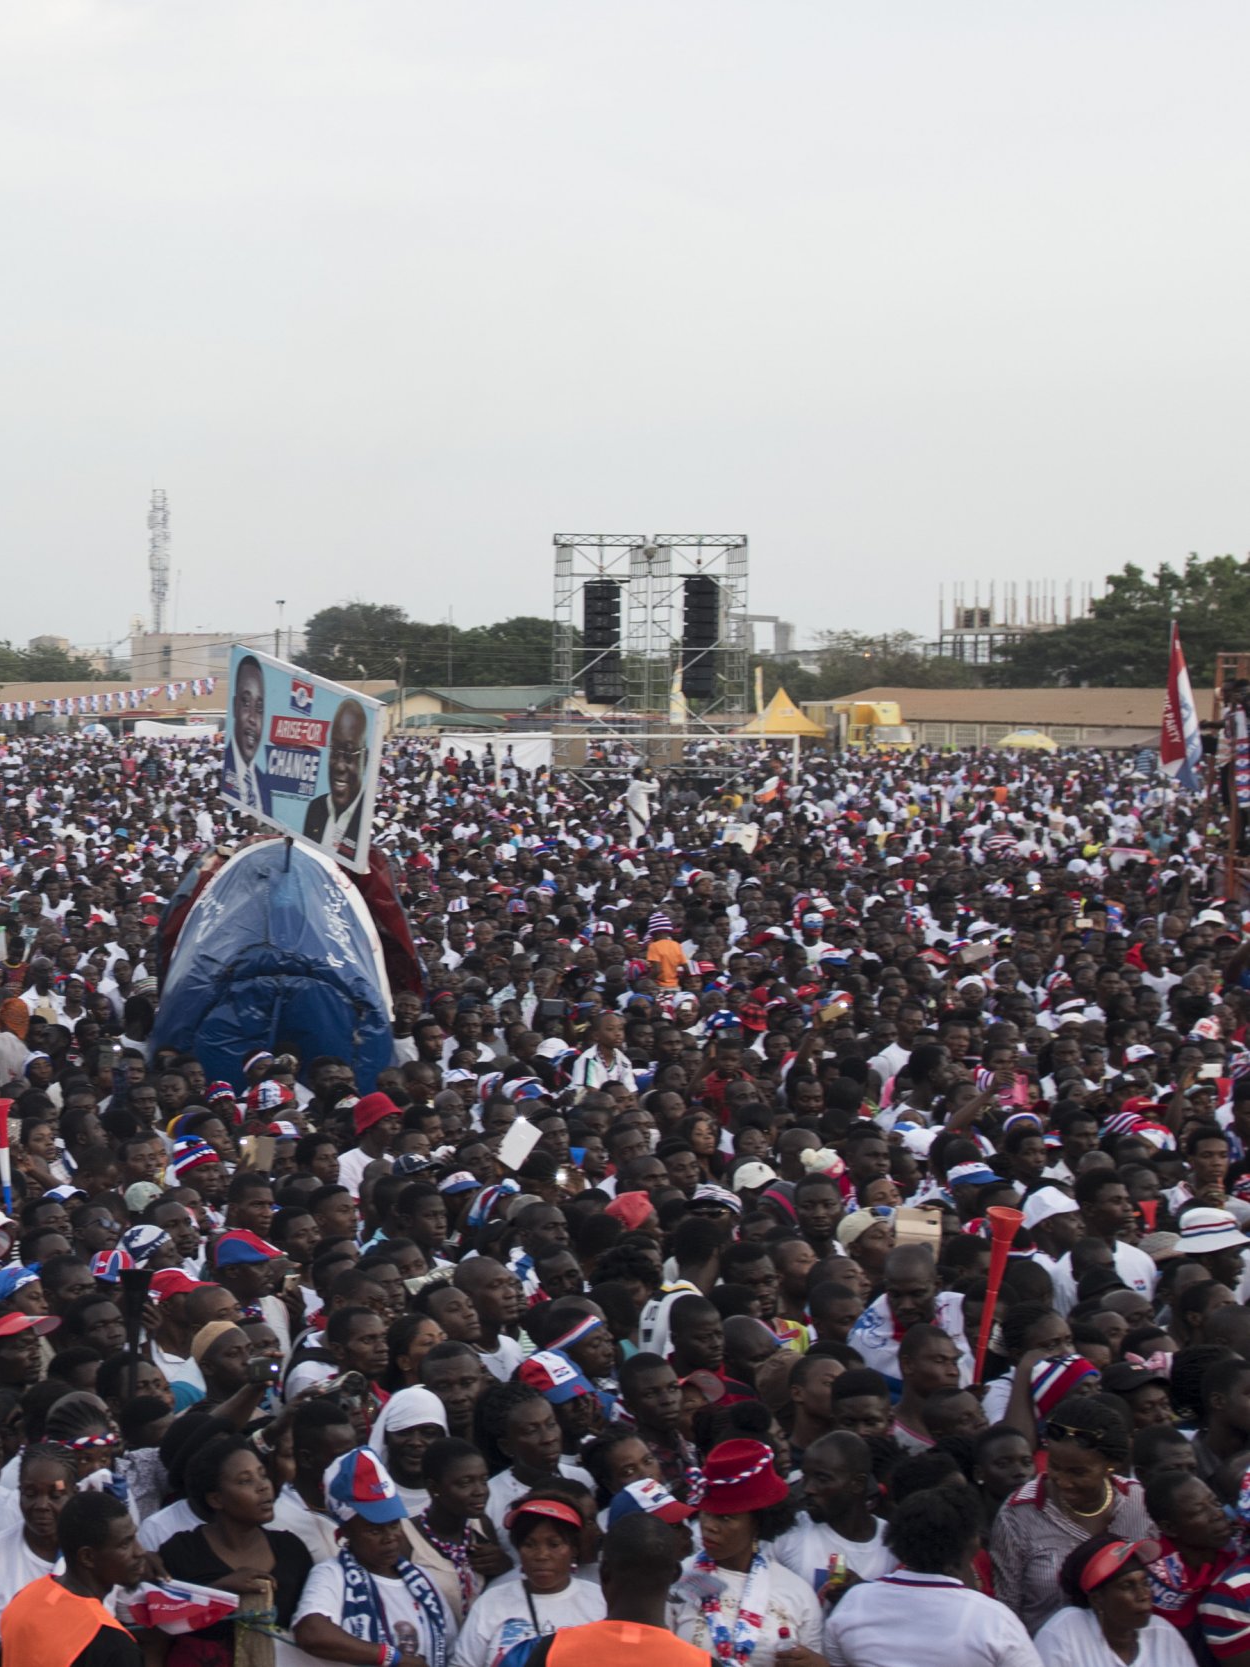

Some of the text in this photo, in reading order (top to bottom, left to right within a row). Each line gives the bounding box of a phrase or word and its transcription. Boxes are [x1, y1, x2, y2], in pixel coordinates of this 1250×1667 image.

[275, 719, 322, 742] ARISE FOR
[1164, 712, 1182, 743] PARTY
[268, 749, 320, 782] CHANGE
